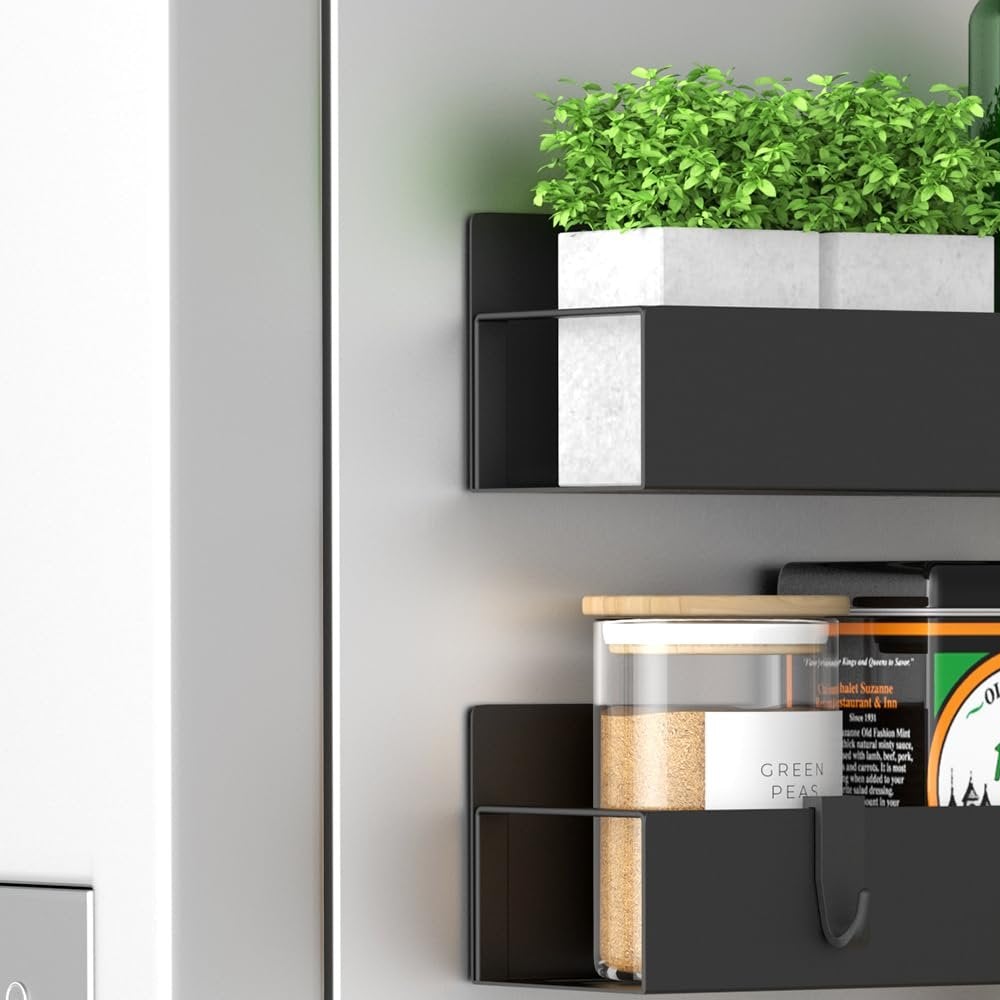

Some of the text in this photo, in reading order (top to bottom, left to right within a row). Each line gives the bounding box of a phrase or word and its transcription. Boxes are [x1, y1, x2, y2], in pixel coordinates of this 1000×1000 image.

[857, 657, 868, 667] and
[860, 681, 894, 695] Suzanne
[873, 696, 882, 709] &
[883, 696, 898, 709] Inn
[848, 712, 864, 722] Since
[861, 727, 872, 738] Old
[873, 727, 896, 738] Fashion
[896, 727, 911, 738] Mint
[760, 762, 824, 778] GREEN
[865, 773, 884, 784] added
[884, 775, 891, 784] to
[771, 784, 819, 799] PEAS
